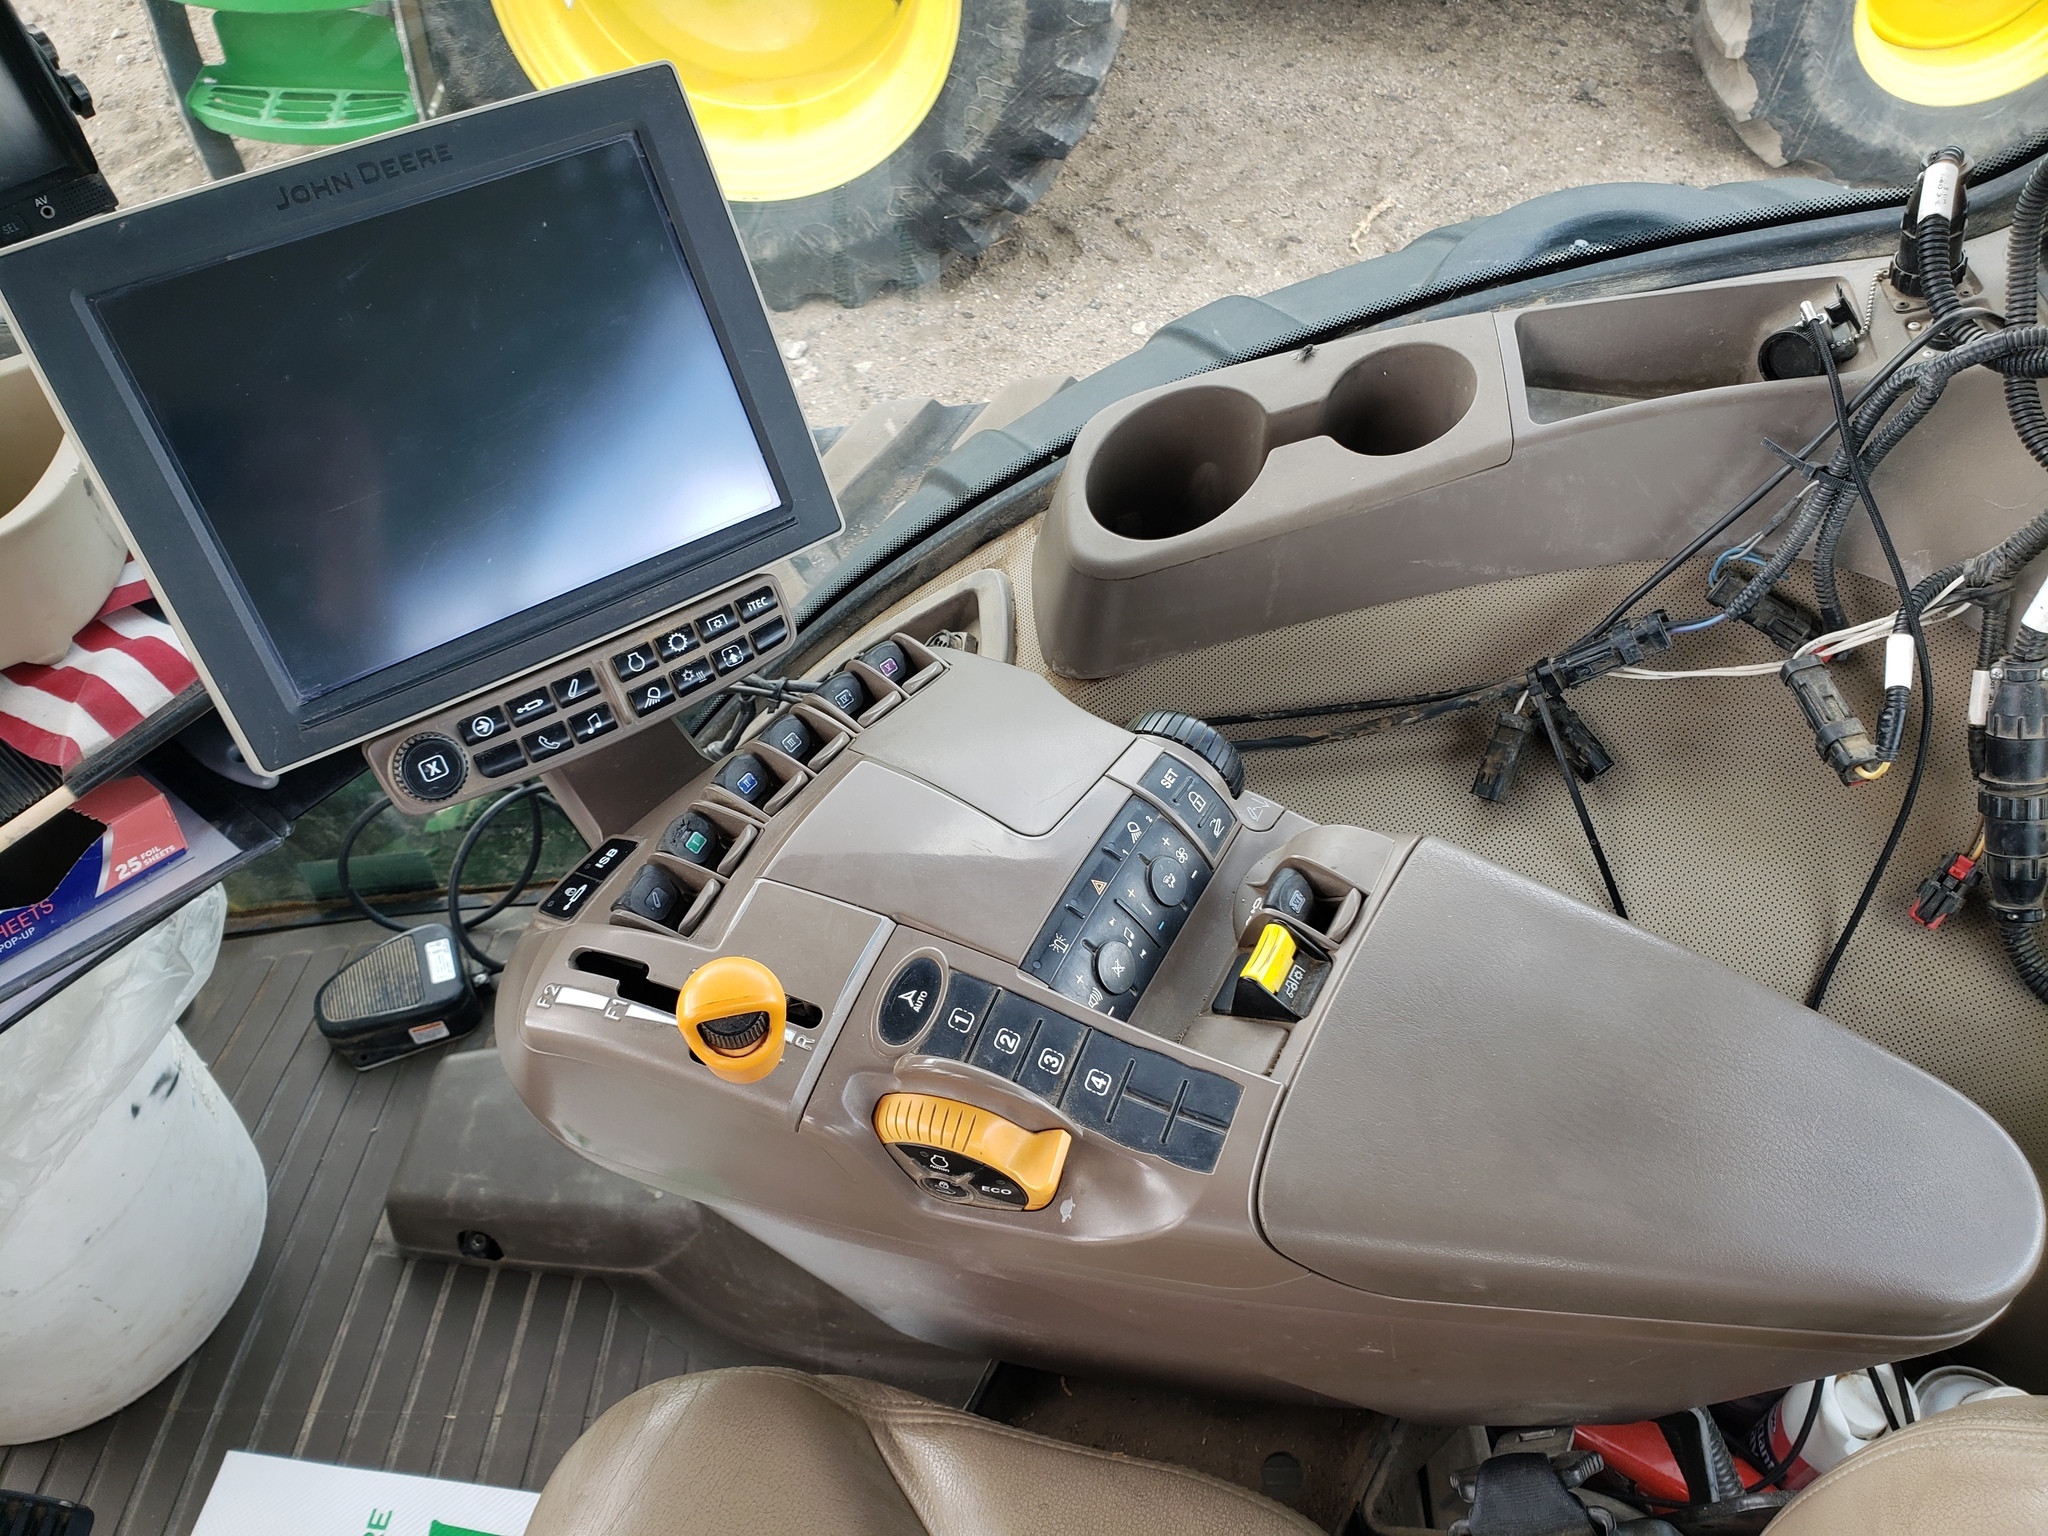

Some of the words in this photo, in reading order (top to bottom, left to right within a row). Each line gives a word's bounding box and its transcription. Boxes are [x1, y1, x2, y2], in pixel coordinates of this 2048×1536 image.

[275, 171, 354, 211] JOHN
[356, 143, 455, 185] DEERE
[34, 195, 48, 208] AV
[2, 222, 20, 235] SEL
[747, 597, 769, 612] iTEC
[1160, 768, 1179, 789] SET
[1145, 815, 1153, 823] 2
[140, 846, 161, 860] FOIL
[143, 844, 176, 866] SHEETS
[594, 848, 619, 868] ISB
[114, 855, 143, 881] 25
[536, 984, 561, 1009] F2
[912, 990, 928, 1013] AUTO
[604, 998, 628, 1021] F1
[954, 1015, 970, 1025] 1
[794, 1036, 816, 1051] R
[999, 1034, 1016, 1049] 2
[1043, 1054, 1060, 1068] 3
[1090, 1075, 1107, 1089] 4
[981, 1185, 1012, 1195] ECO
